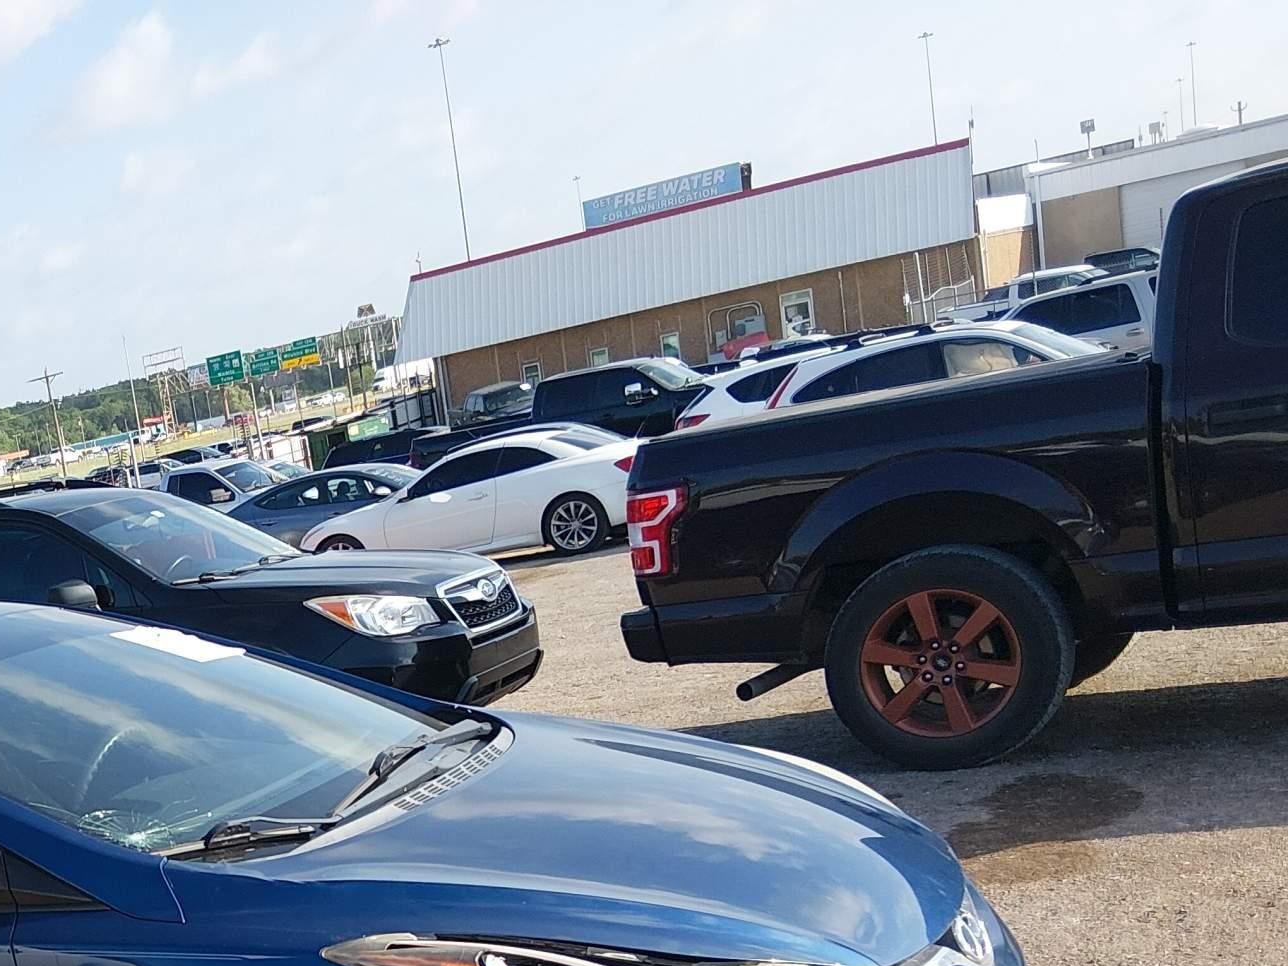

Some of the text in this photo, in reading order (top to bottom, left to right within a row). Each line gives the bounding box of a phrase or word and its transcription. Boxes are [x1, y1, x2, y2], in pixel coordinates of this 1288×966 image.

[592, 168, 726, 209] GET FREE WATER
[602, 186, 718, 223] FOR LAWN IRRIGATION
